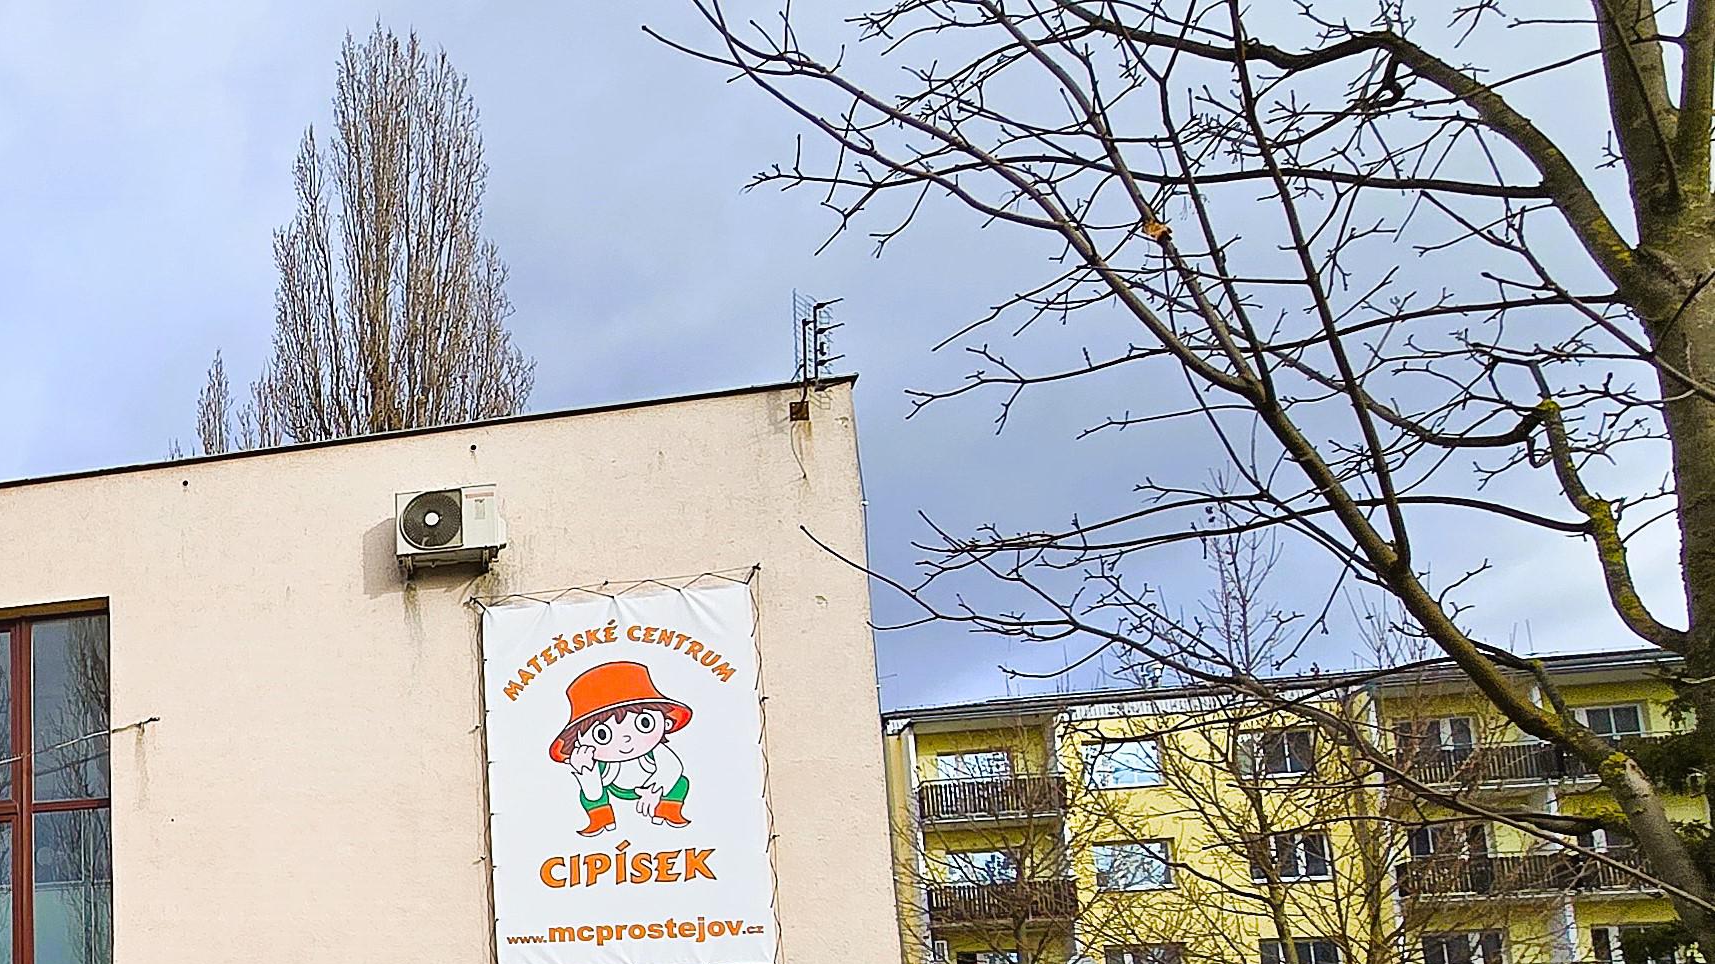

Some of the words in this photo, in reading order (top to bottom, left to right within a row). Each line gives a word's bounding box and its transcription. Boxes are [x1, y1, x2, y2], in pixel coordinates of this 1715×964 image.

[503, 619, 618, 701] MATEŘSKÉ
[626, 625, 736, 683] CENTRUM
[540, 839, 717, 889] CIPÍSEK
[507, 917, 764, 946] www.mcprostejov.cz
